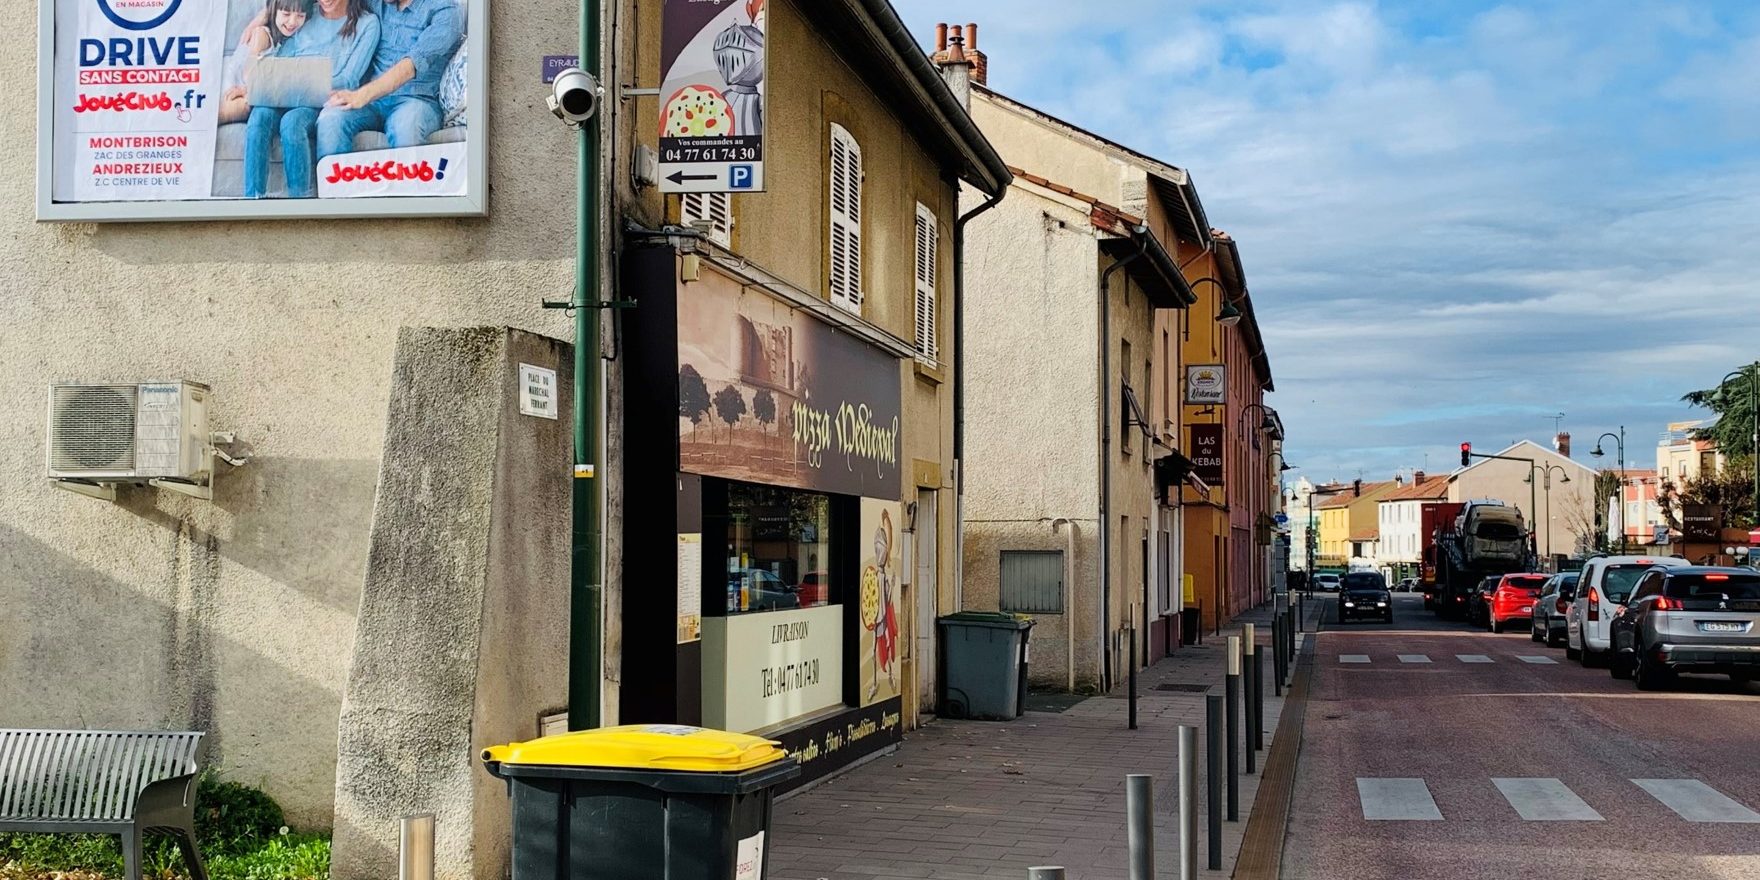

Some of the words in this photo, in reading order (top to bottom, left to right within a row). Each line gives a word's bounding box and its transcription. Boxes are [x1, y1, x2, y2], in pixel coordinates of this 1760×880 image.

[80, 36, 200, 67] DRIVE
[80, 70, 123, 84] SANS
[126, 69, 199, 83] CONTACT
[89, 136, 188, 148] MONTBRISON
[692, 138, 733, 146] commandes
[94, 151, 113, 160] ZAC
[116, 151, 134, 160] DES
[136, 150, 182, 160] GRANGES
[666, 149, 681, 161] 04
[684, 148, 700, 161] 77
[702, 148, 717, 160] 61
[721, 148, 736, 160] 74
[739, 147, 755, 160] 30
[92, 163, 183, 175] ANDREZIEUX
[112, 177, 148, 186] CENTRE
[151, 177, 164, 186] DE
[167, 177, 180, 186] VIE
[733, 167, 748, 187] P
[528, 373, 540, 384] PLACE
[542, 375, 549, 386] DU
[143, 386, 177, 394] Panasonic
[792, 400, 832, 476] pizza
[1202, 447, 1212, 455] du
[1191, 457, 1222, 467] KEBAB
[771, 620, 810, 645] LIVRAISON
